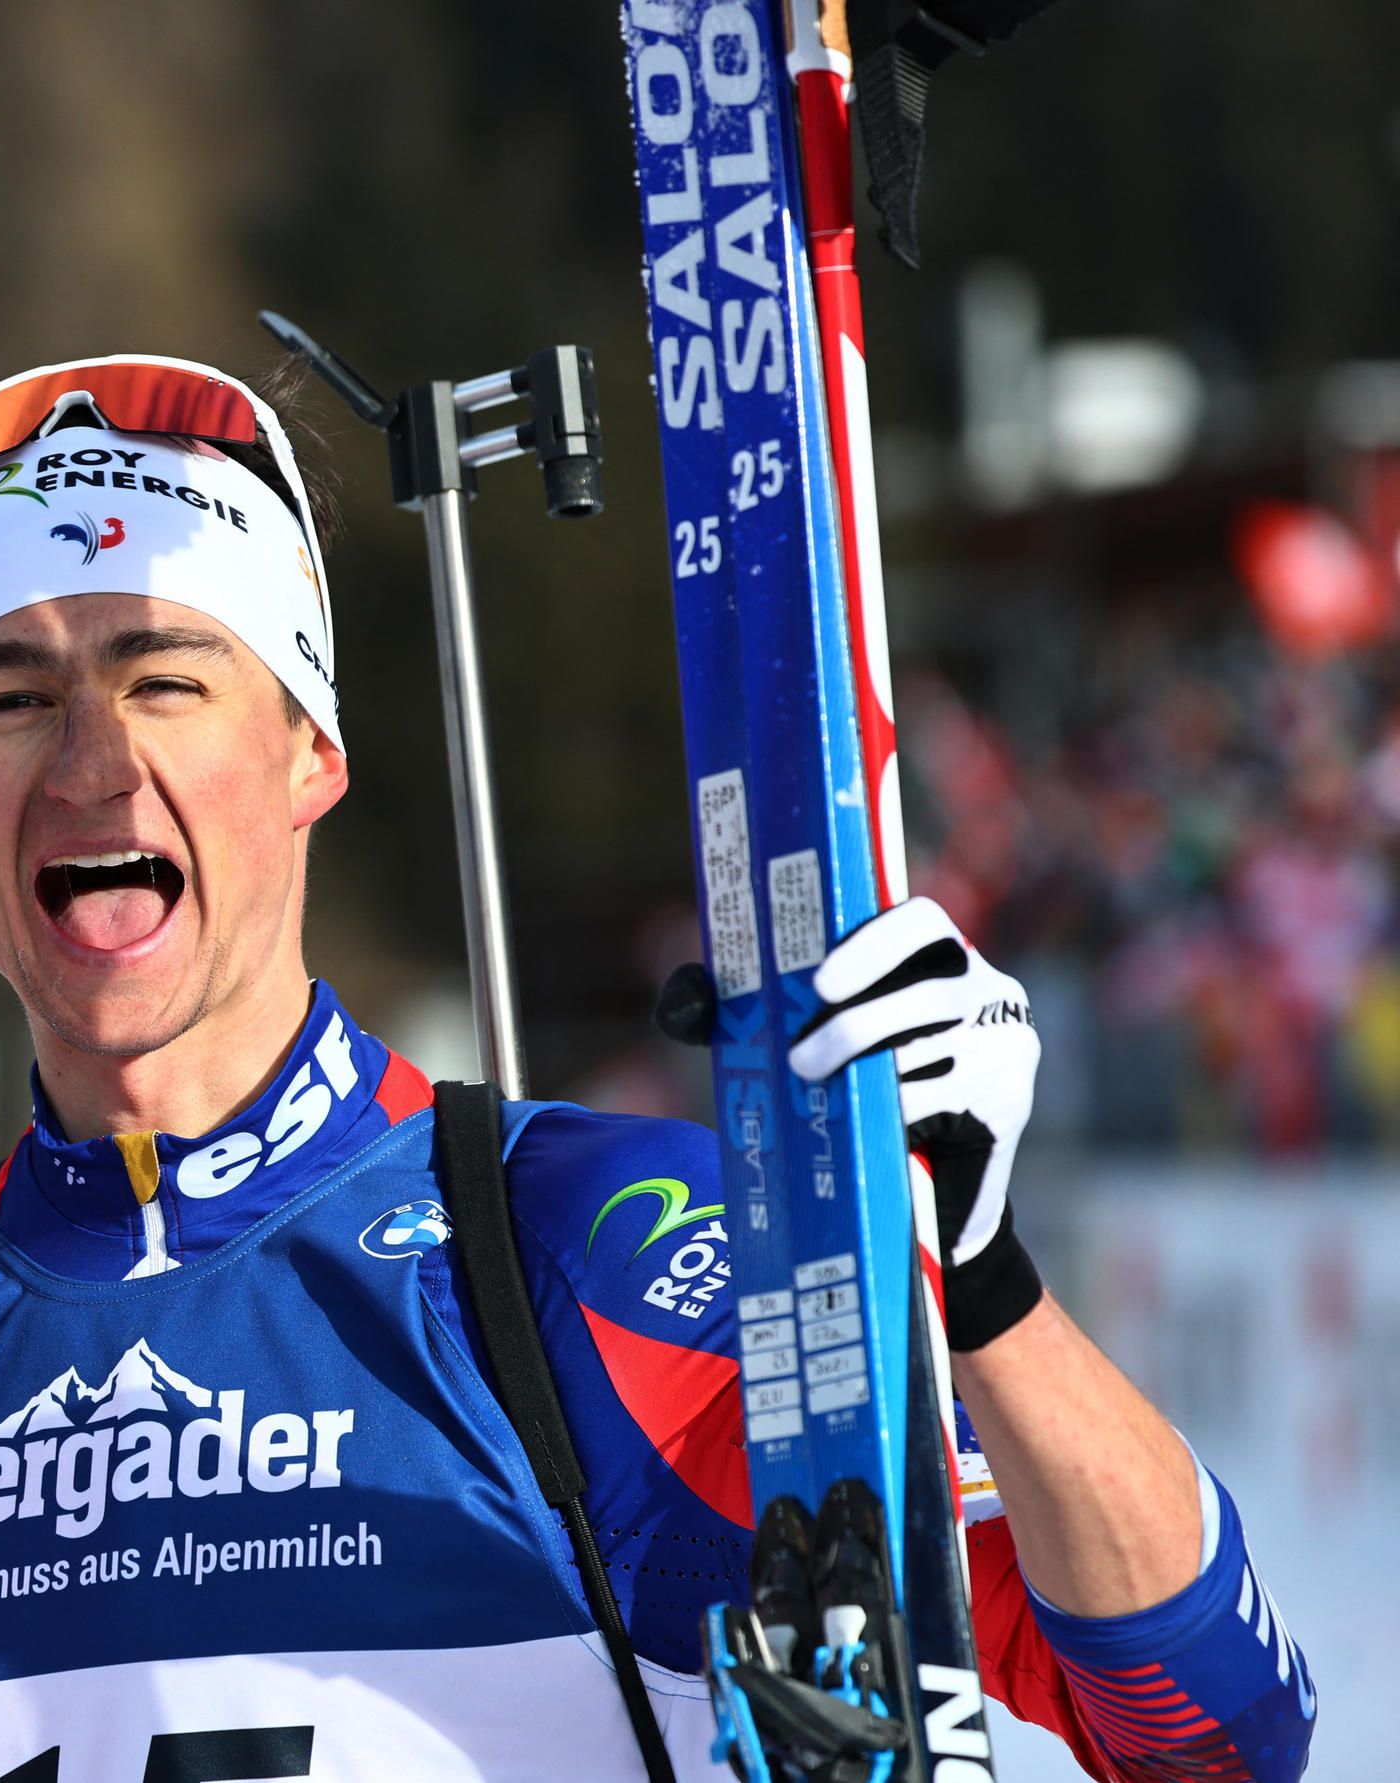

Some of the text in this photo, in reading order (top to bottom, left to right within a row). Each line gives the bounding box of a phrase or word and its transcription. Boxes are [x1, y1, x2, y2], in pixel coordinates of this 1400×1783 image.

[37, 449, 147, 473] ROY
[731, 440, 785, 512] 25
[35, 470, 249, 534] ENERGIE
[675, 516, 721, 578] 25
[643, 1220, 729, 1311] ROY
[79, 1547, 141, 1586] aus
[153, 1521, 383, 1586] Alpenmilch
